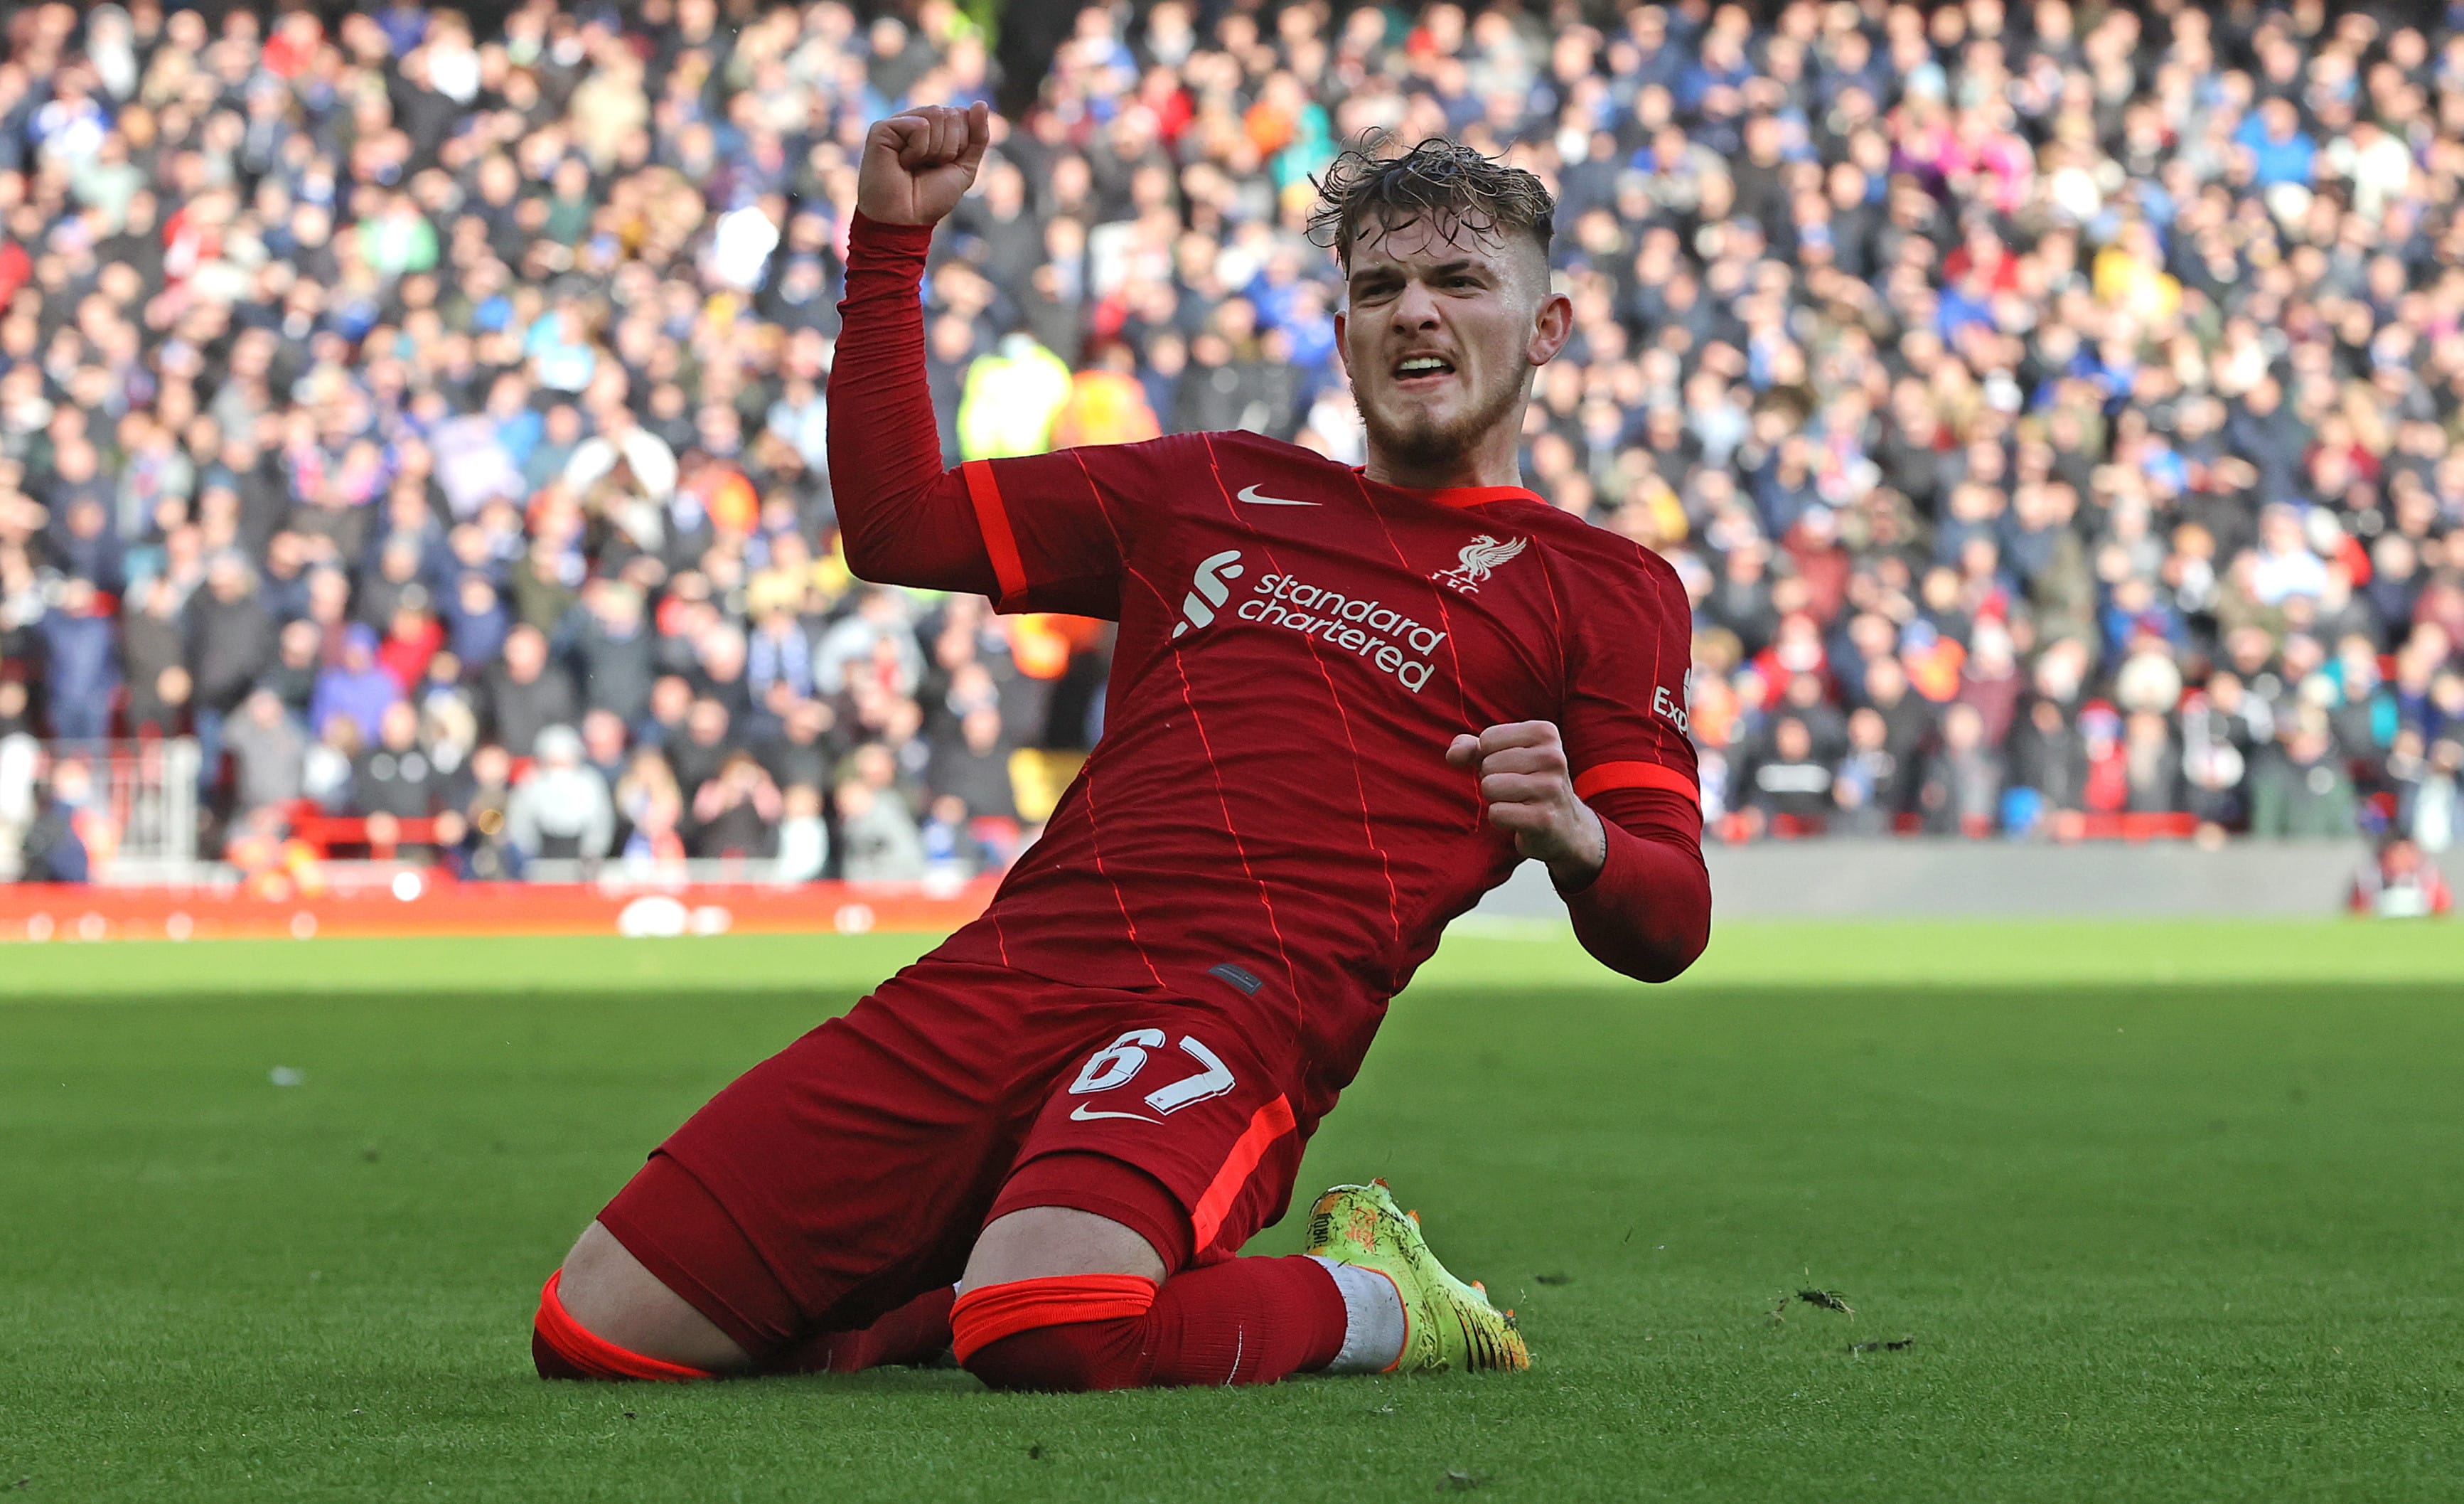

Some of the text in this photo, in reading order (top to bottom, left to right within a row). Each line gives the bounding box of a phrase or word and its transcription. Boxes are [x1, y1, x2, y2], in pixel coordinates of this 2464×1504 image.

[1238, 598, 1436, 694] chartered
[1253, 573, 1447, 656] standard
[1068, 1028, 1236, 1116] 67
